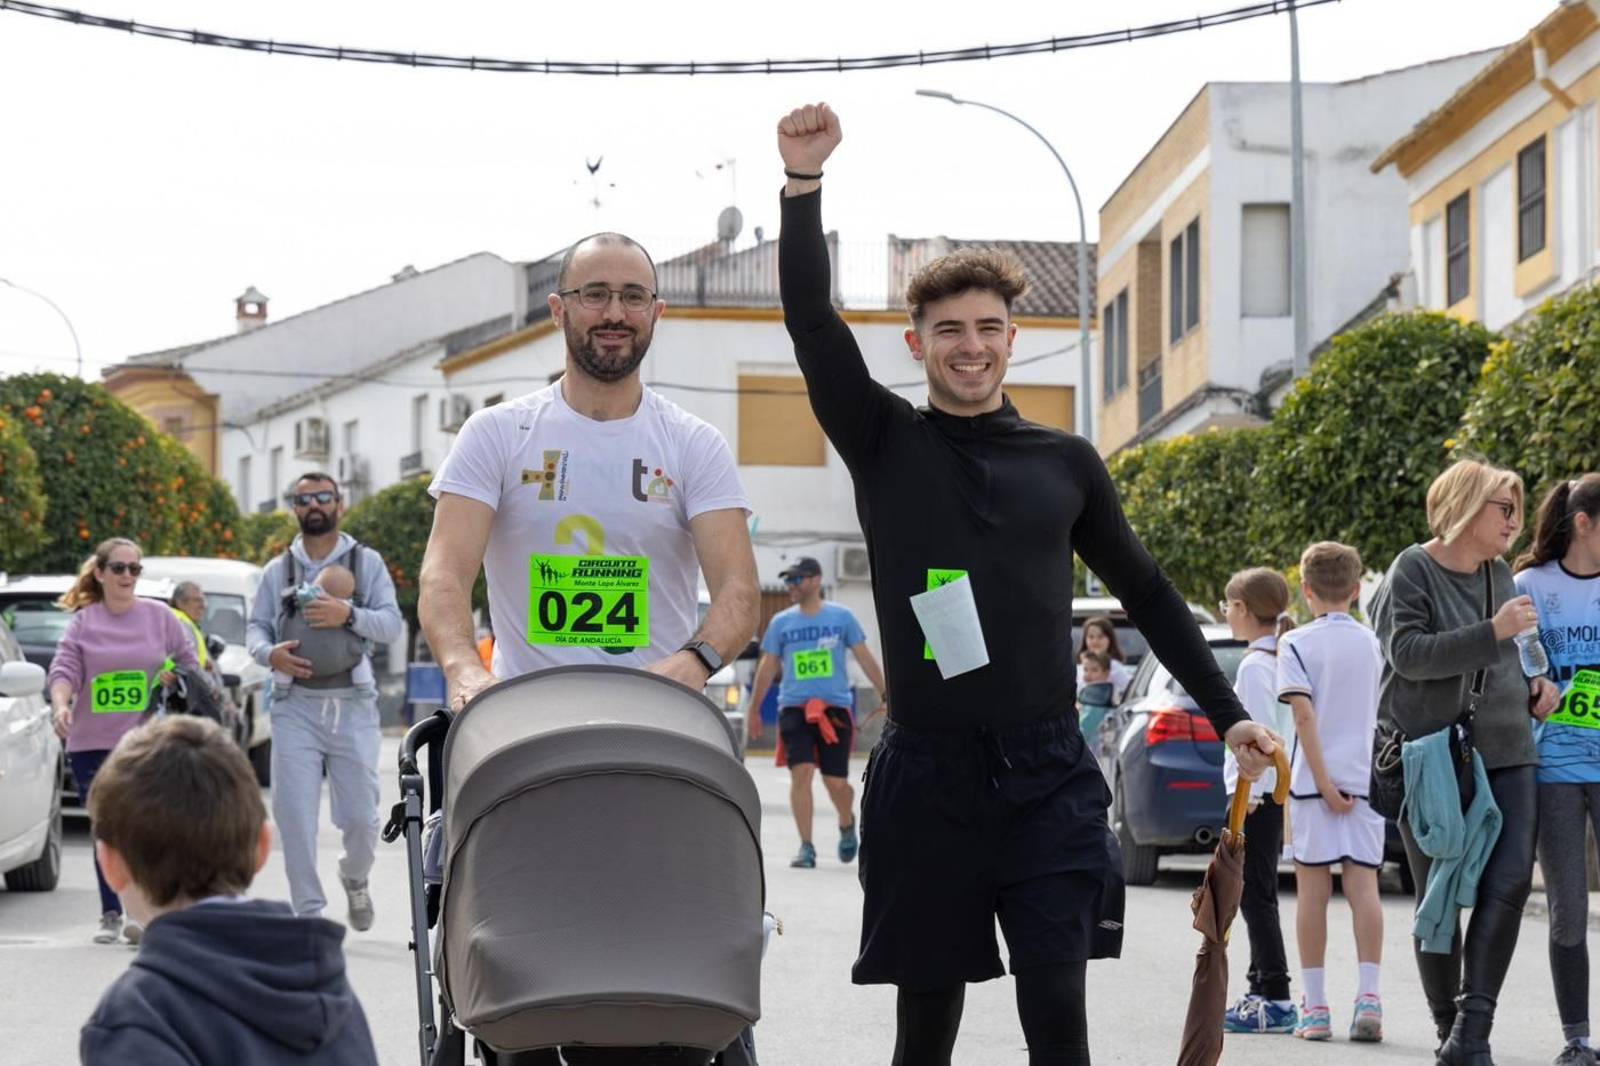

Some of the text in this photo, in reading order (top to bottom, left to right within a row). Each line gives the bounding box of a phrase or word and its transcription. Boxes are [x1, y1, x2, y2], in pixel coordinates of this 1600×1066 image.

[578, 559, 637, 568] CIRCUITO
[571, 567, 643, 578] RUNNING
[598, 580, 615, 588] Lope
[616, 578, 640, 587] Álvarez
[538, 590, 639, 632] 024
[555, 634, 567, 643] DÍA
[579, 635, 622, 644] ANDALUCÍA
[797, 660, 828, 675] 061
[96, 686, 142, 706] 059
